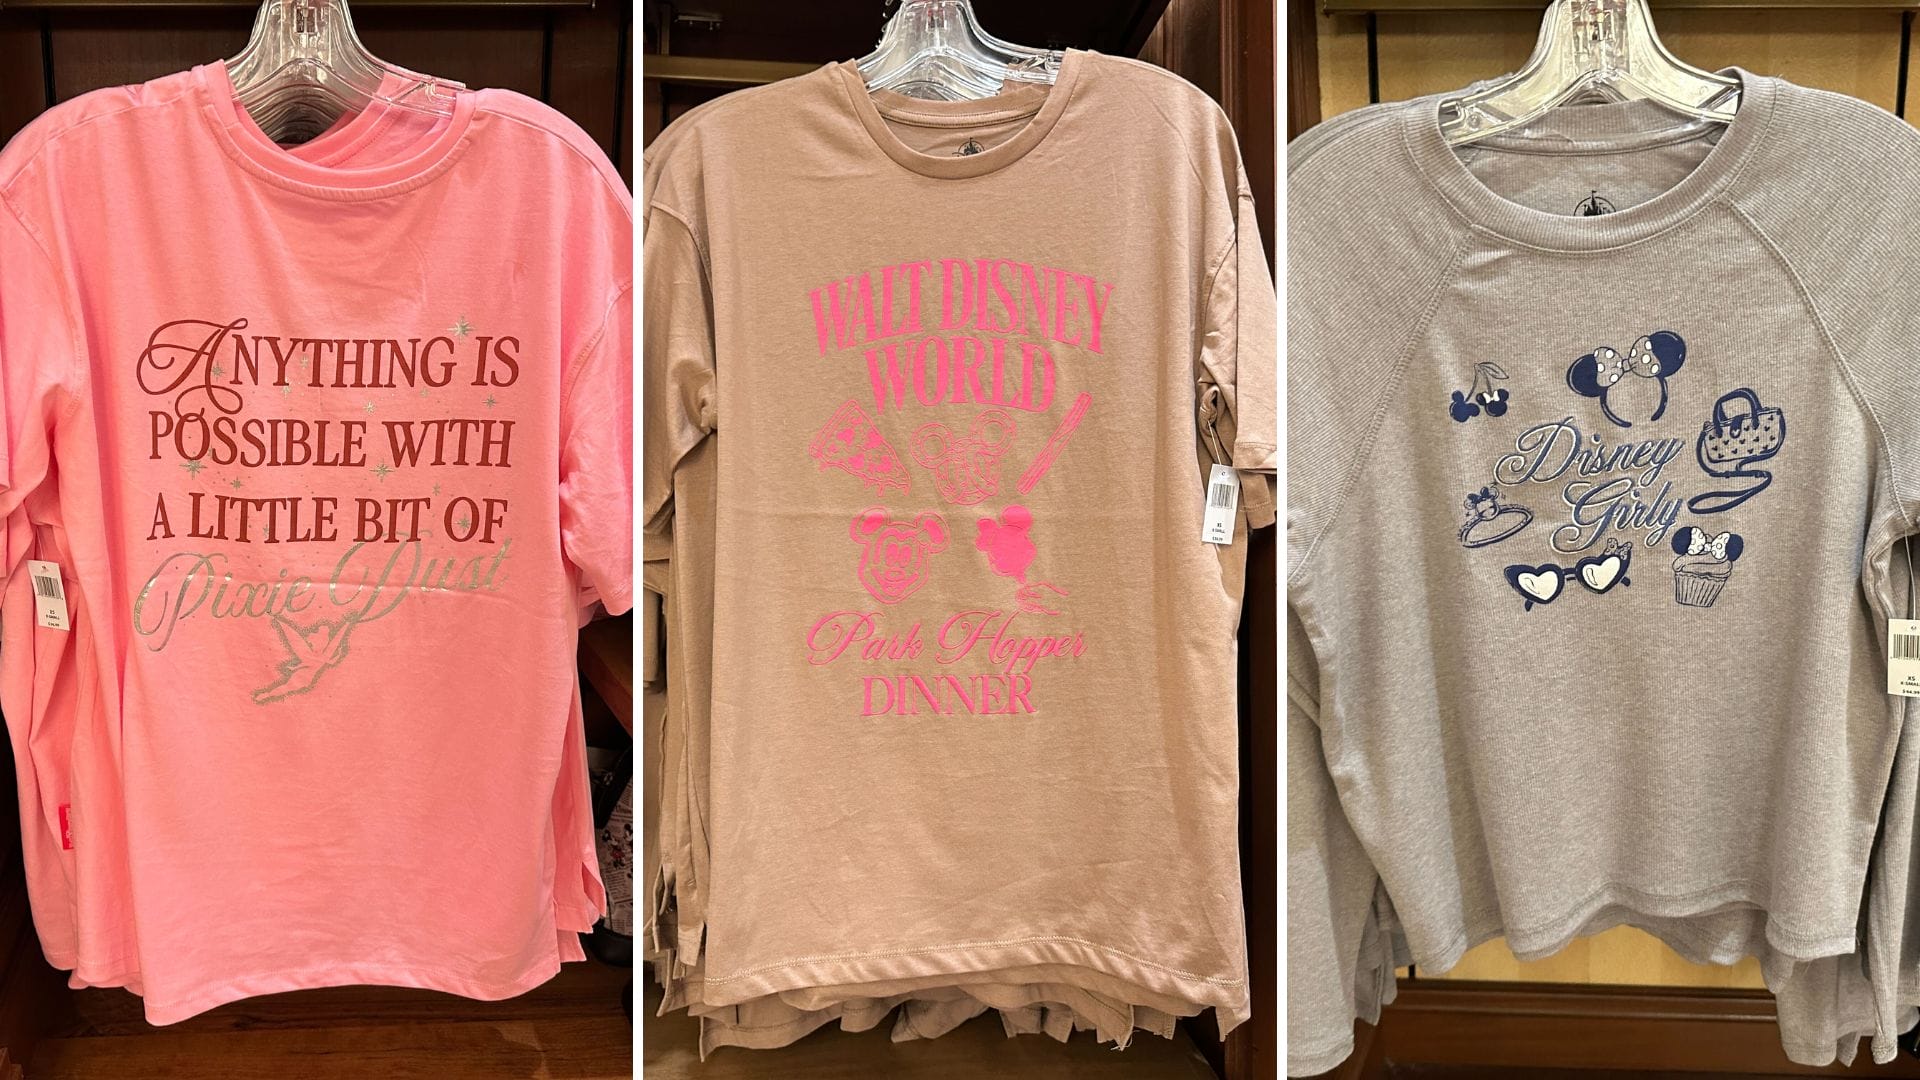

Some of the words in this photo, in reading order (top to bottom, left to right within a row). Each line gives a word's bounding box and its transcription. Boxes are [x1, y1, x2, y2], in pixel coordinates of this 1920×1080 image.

[808, 259, 933, 357] WALT
[939, 258, 1115, 355] DISNEY
[136, 318, 457, 423] ANYTHING
[473, 336, 520, 388] IS
[864, 336, 1057, 415] WORLD
[149, 409, 366, 468] POSSIBLE
[382, 419, 516, 468] WITH
[1494, 416, 1686, 487] Disney
[146, 492, 175, 541] A
[187, 492, 338, 544] LITTLE
[353, 497, 430, 544] BIT
[443, 496, 508, 544] OF
[1550, 477, 1683, 554] Girly
[133, 552, 317, 652] Pixie
[329, 530, 513, 623] Dust
[806, 610, 926, 666] Park
[935, 609, 1088, 675] Hopper
[862, 674, 1037, 717] DINNER
